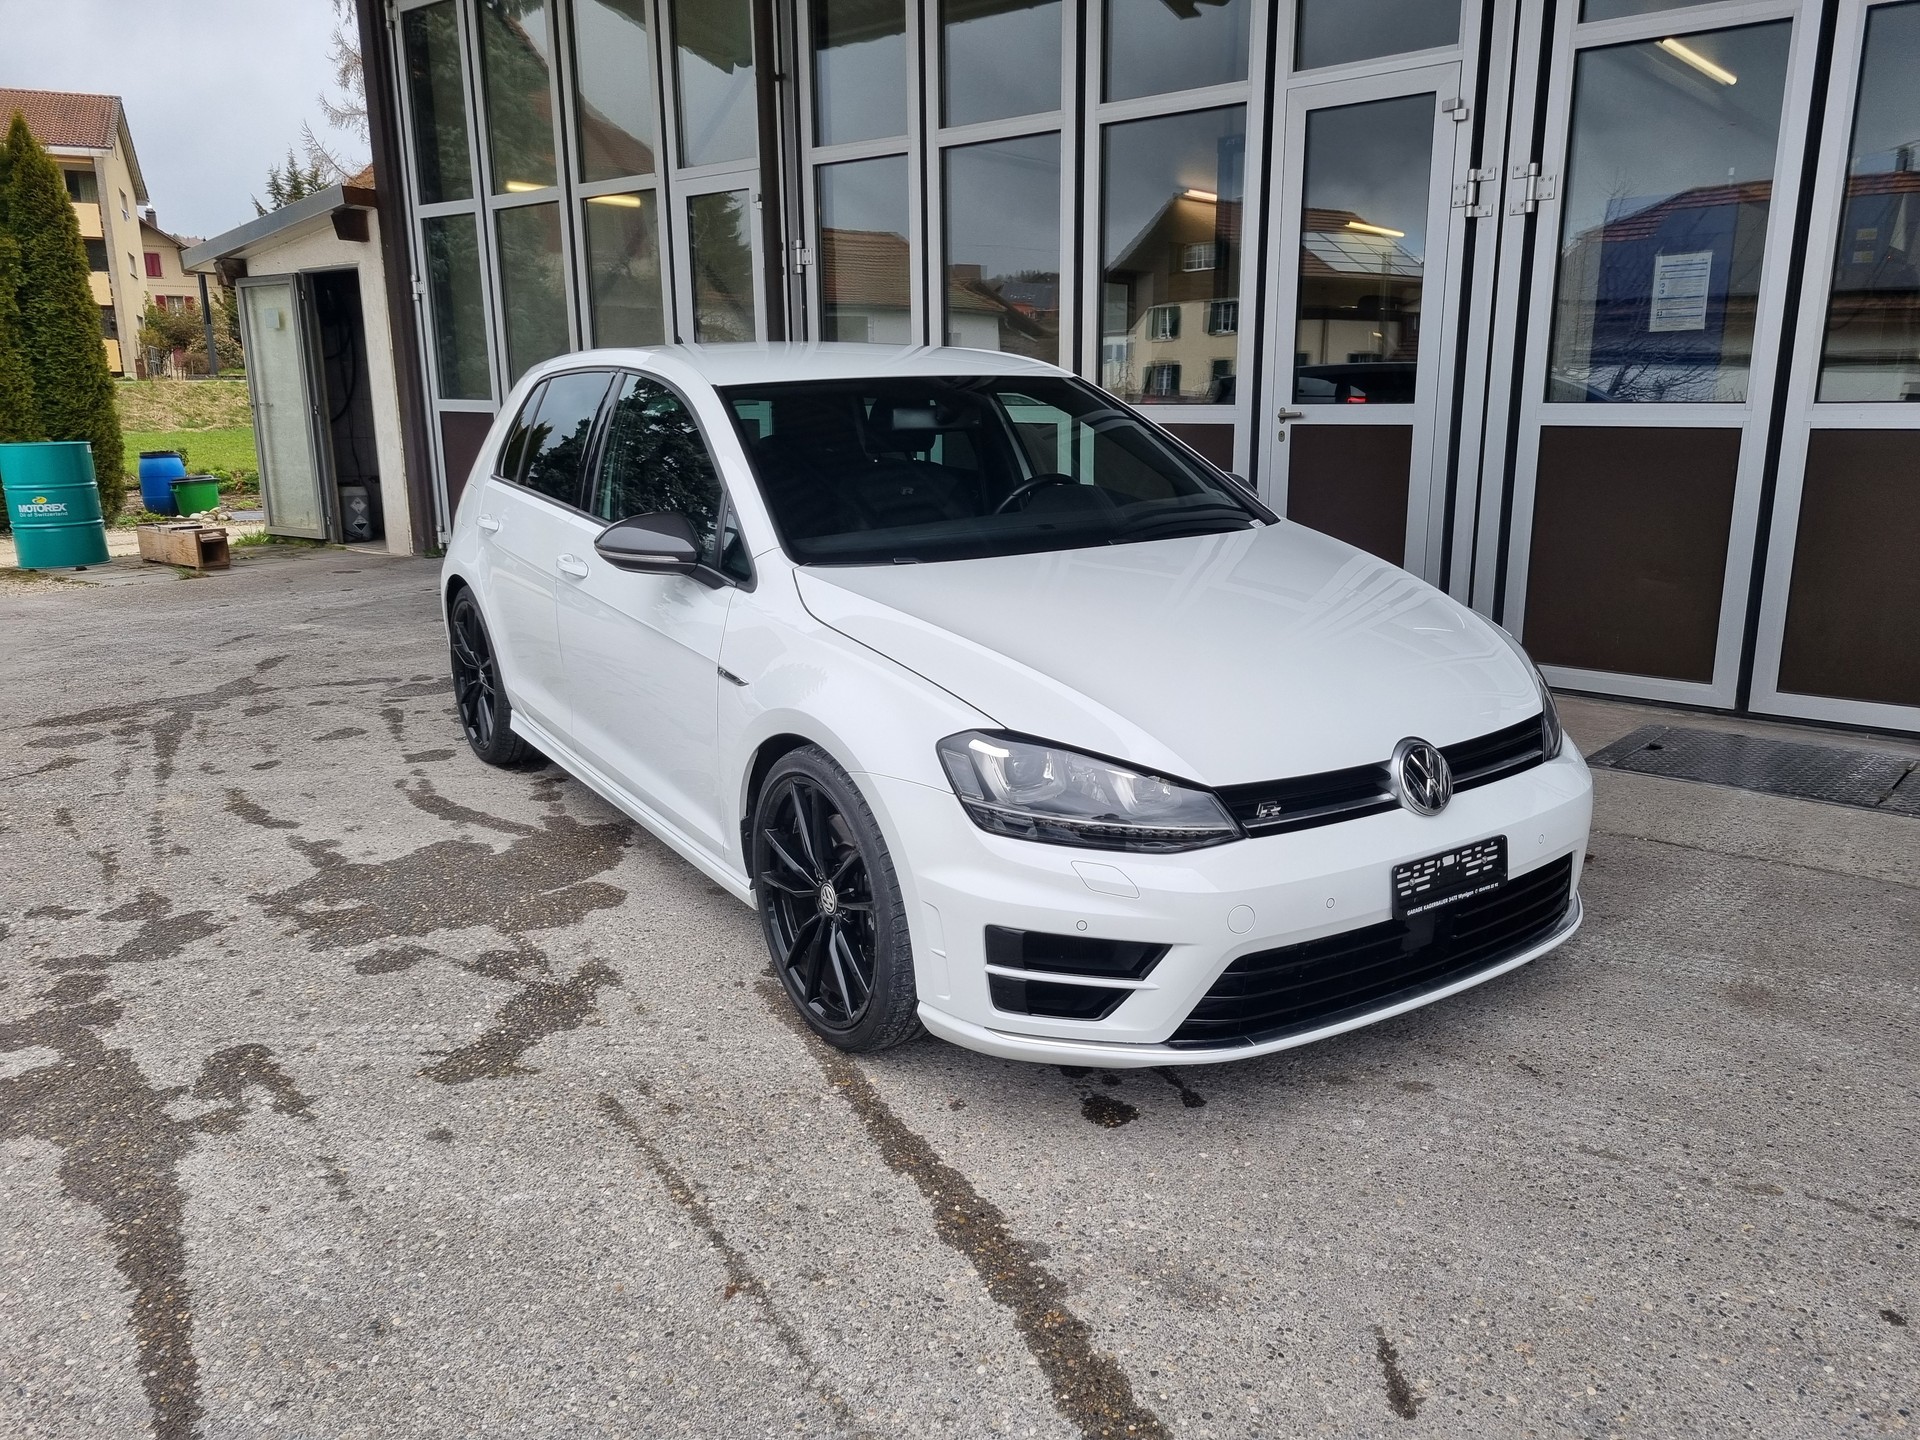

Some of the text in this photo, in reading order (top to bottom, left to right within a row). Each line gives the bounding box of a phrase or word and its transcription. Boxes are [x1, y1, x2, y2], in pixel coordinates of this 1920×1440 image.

[17, 503, 68, 513] MOTOREX
[1256, 801, 1282, 819] R
[1406, 905, 1423, 916] GARAGE
